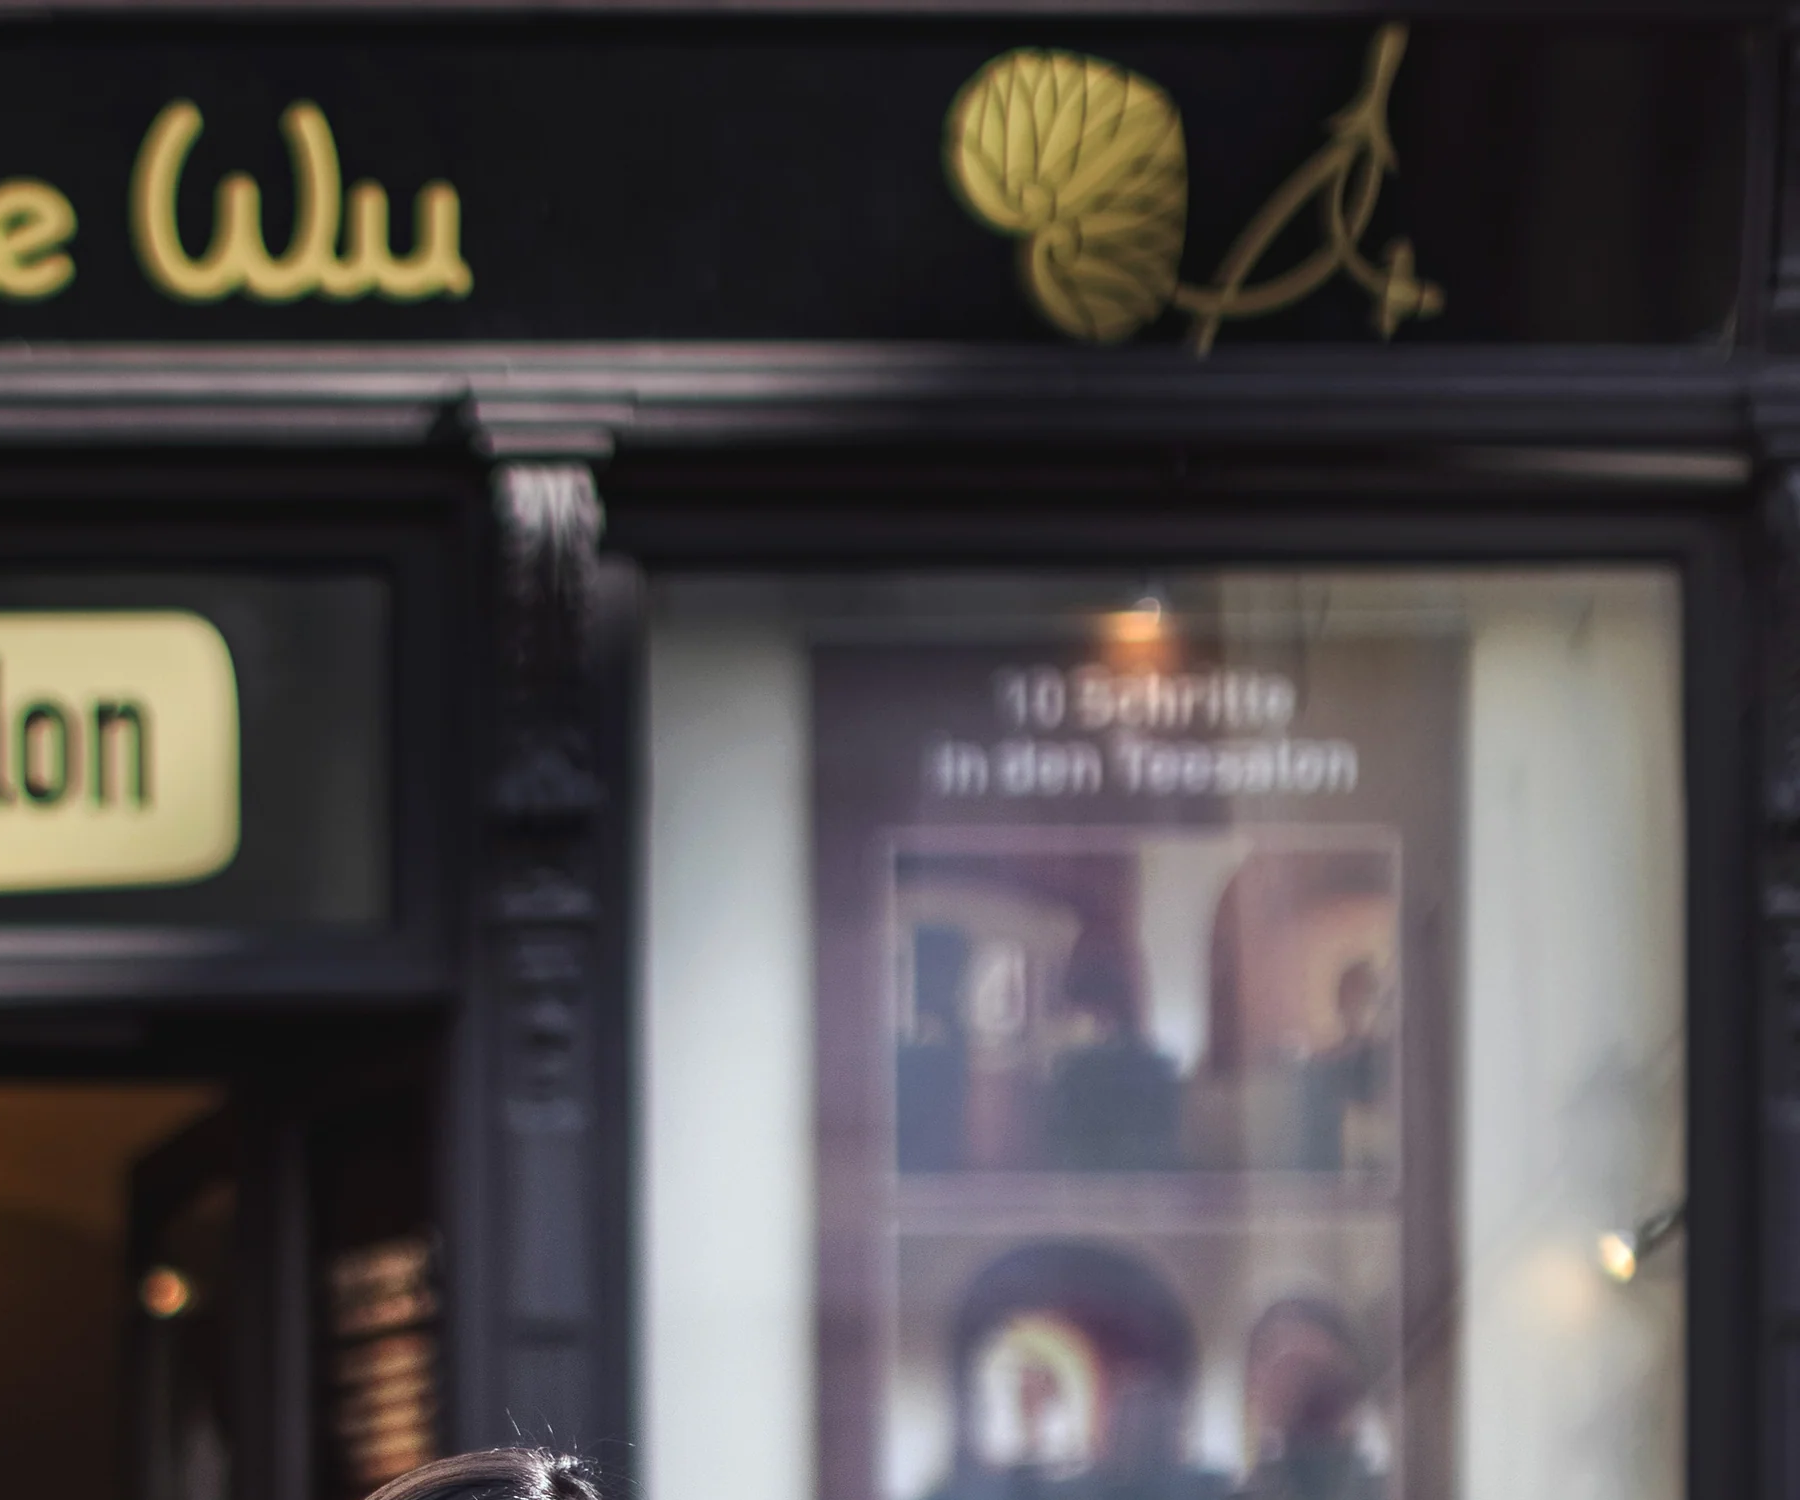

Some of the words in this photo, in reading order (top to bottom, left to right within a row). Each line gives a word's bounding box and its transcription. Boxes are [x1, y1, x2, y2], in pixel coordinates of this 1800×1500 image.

[129, 96, 476, 302] Wu
[998, 666, 1068, 730] 10
[1073, 664, 1298, 730] Schritte
[998, 735, 1101, 797] den
[1114, 736, 1360, 798] Teesalon
